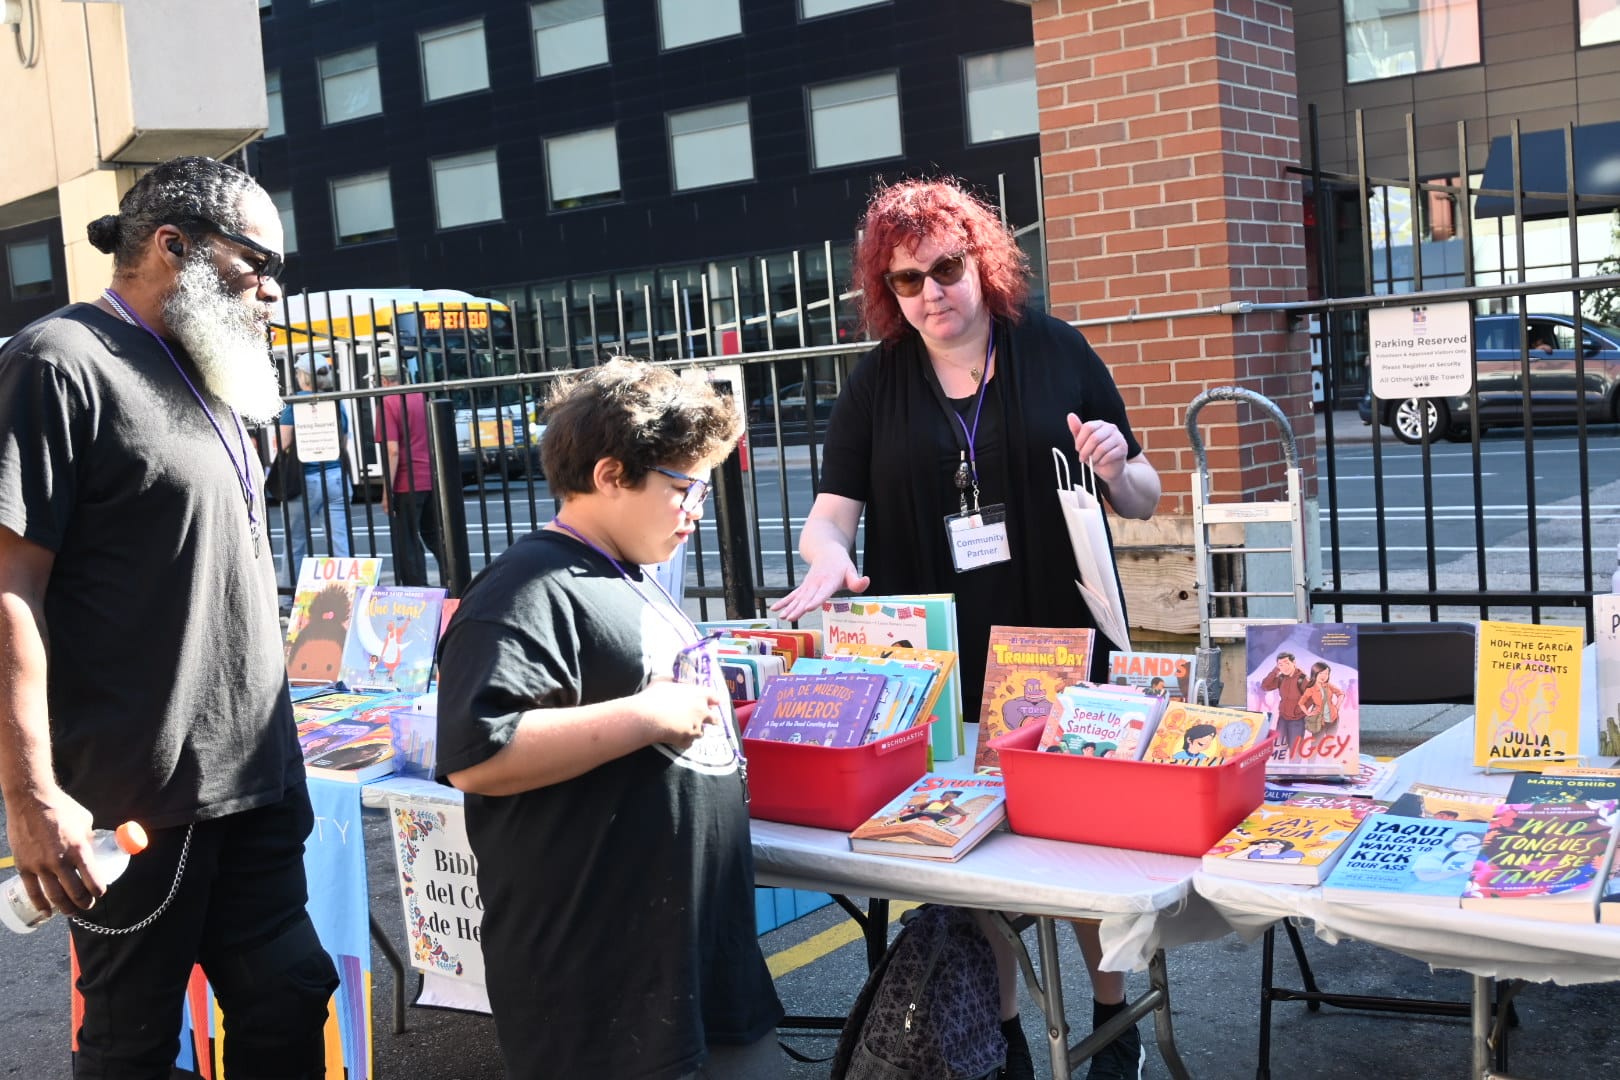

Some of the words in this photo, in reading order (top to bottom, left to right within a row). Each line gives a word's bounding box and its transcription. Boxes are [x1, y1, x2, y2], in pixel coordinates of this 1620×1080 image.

[459, 311, 488, 329] FELD
[1375, 338, 1414, 348] Parking
[1417, 335, 1467, 346] Reserved
[956, 534, 1004, 548] Community
[967, 547, 998, 558] Partner
[313, 559, 360, 580] LOLA
[829, 625, 867, 644] Mamá
[1490, 639, 1512, 649] HOW
[1515, 641, 1534, 650] THE
[992, 644, 1055, 666] TRAINING
[1055, 646, 1084, 667] DAY
[1502, 651, 1532, 661] GIRLS
[1534, 653, 1558, 663] LOST
[1113, 655, 1187, 678] HANDS
[1492, 660, 1522, 671] THEIR
[1525, 663, 1568, 674] ACCENTS
[797, 683, 810, 696] DE
[812, 683, 855, 701] MUERTOS
[1073, 708, 1106, 722] Speak
[770, 721, 780, 729] Day
[1066, 720, 1121, 741] Santiago!
[886, 730, 924, 747] SCHOLASTIC
[1274, 735, 1288, 748] LL
[1504, 731, 1551, 747] JULIA
[1290, 734, 1351, 760] IGGY
[1527, 778, 1563, 786] MARK
[1567, 780, 1616, 788] OSHIRO
[1372, 821, 1453, 837] YAQUI
[1517, 816, 1589, 837] WILD
[1358, 841, 1417, 853] WANTS
[1364, 832, 1444, 846] DELGADO
[1496, 835, 1601, 853] TONGUES
[1350, 850, 1414, 864] KICK
[1486, 851, 1558, 867] CAN'T
[1553, 853, 1591, 870] BE
[1346, 861, 1379, 869] YOUR
[1381, 863, 1408, 871] ASS
[1485, 868, 1582, 885] TAMED
[426, 880, 455, 906] del
[429, 912, 451, 936] de
[457, 916, 481, 942] He
